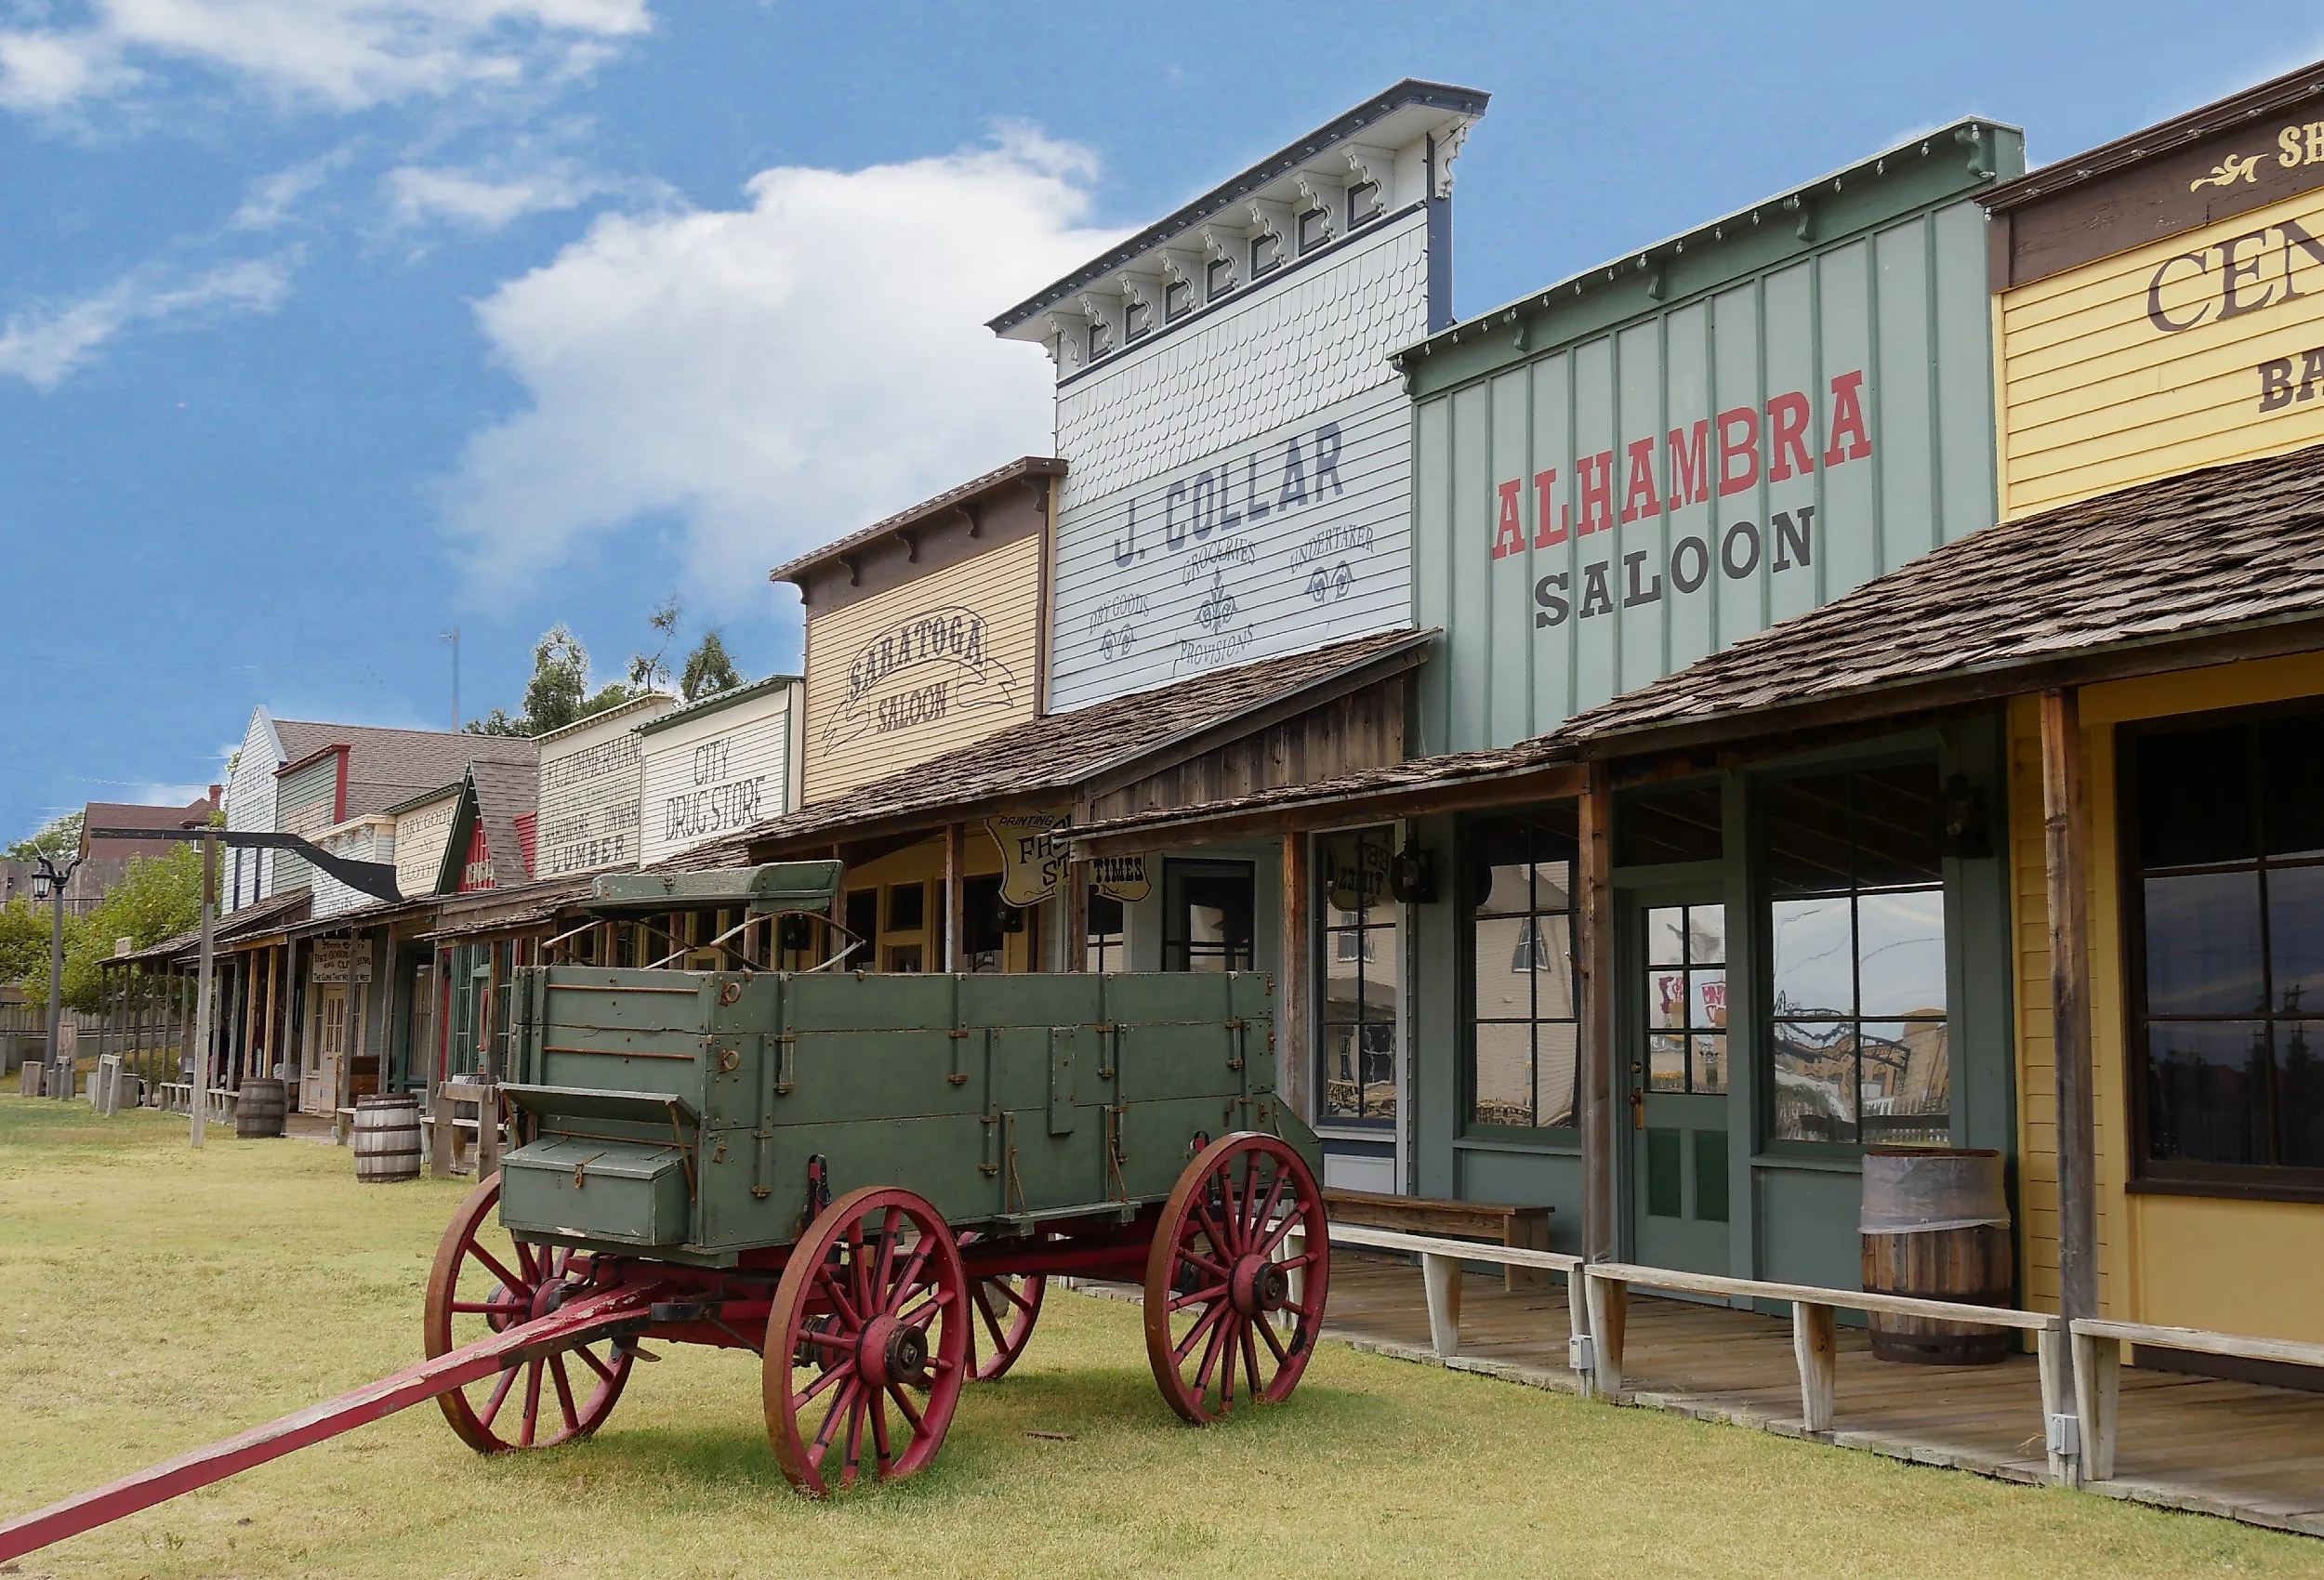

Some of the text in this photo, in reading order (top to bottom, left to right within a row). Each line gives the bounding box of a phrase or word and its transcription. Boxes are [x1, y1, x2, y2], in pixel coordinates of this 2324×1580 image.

[1492, 369, 1871, 560] ALHAMBRA
[1115, 421, 1344, 568] J. COLLAR
[1182, 536, 1256, 586] GROCERIES
[1289, 524, 1375, 574] UNDERTAKER
[1535, 505, 1815, 629] SALOON
[850, 615, 984, 700] SARATOGA
[1180, 623, 1255, 665] PROVISIONS
[877, 681, 949, 735] SALOON
[693, 737, 732, 786] CITY
[998, 815, 1055, 826] PRINTING
[552, 835, 625, 874] LUMBER
[1093, 856, 1144, 883] TIMES
